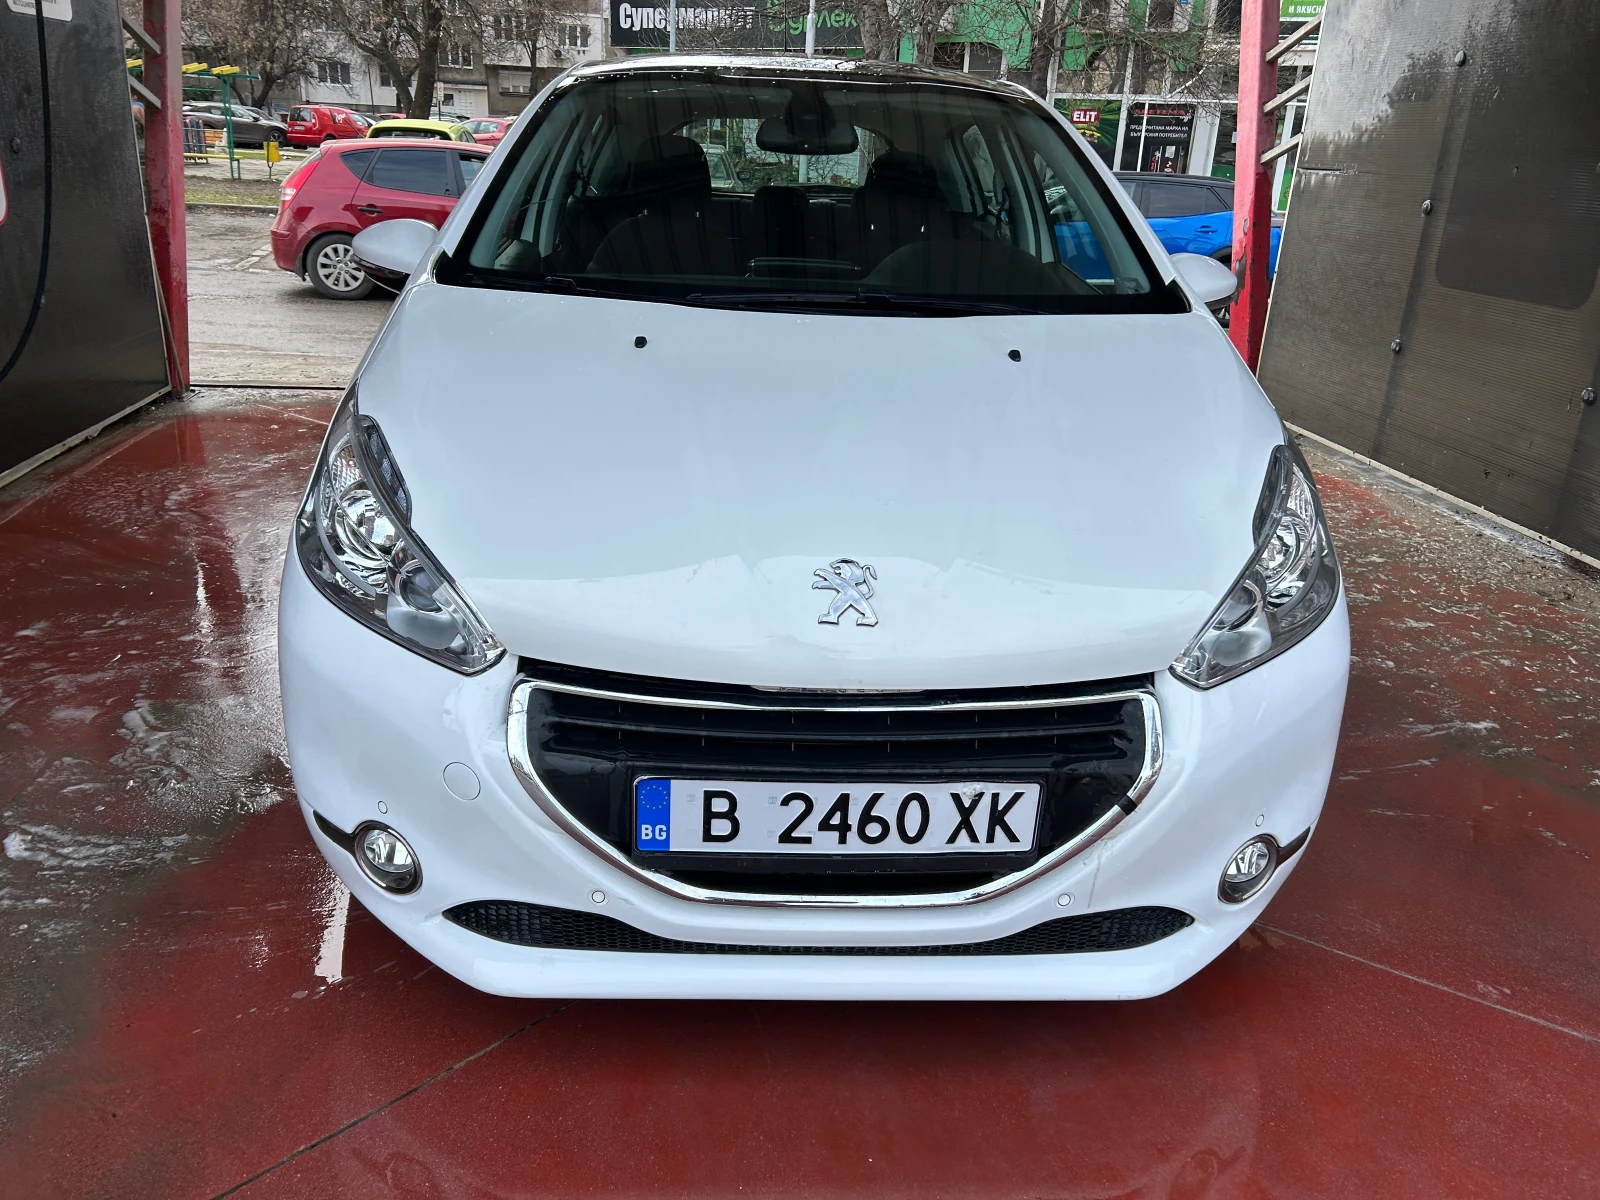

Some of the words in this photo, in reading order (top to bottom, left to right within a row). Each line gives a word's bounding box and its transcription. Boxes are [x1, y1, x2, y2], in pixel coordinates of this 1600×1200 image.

[641, 824, 667, 841] BG
[702, 789, 741, 843] B
[778, 792, 931, 845] 2460
[945, 791, 1026, 844] XK
